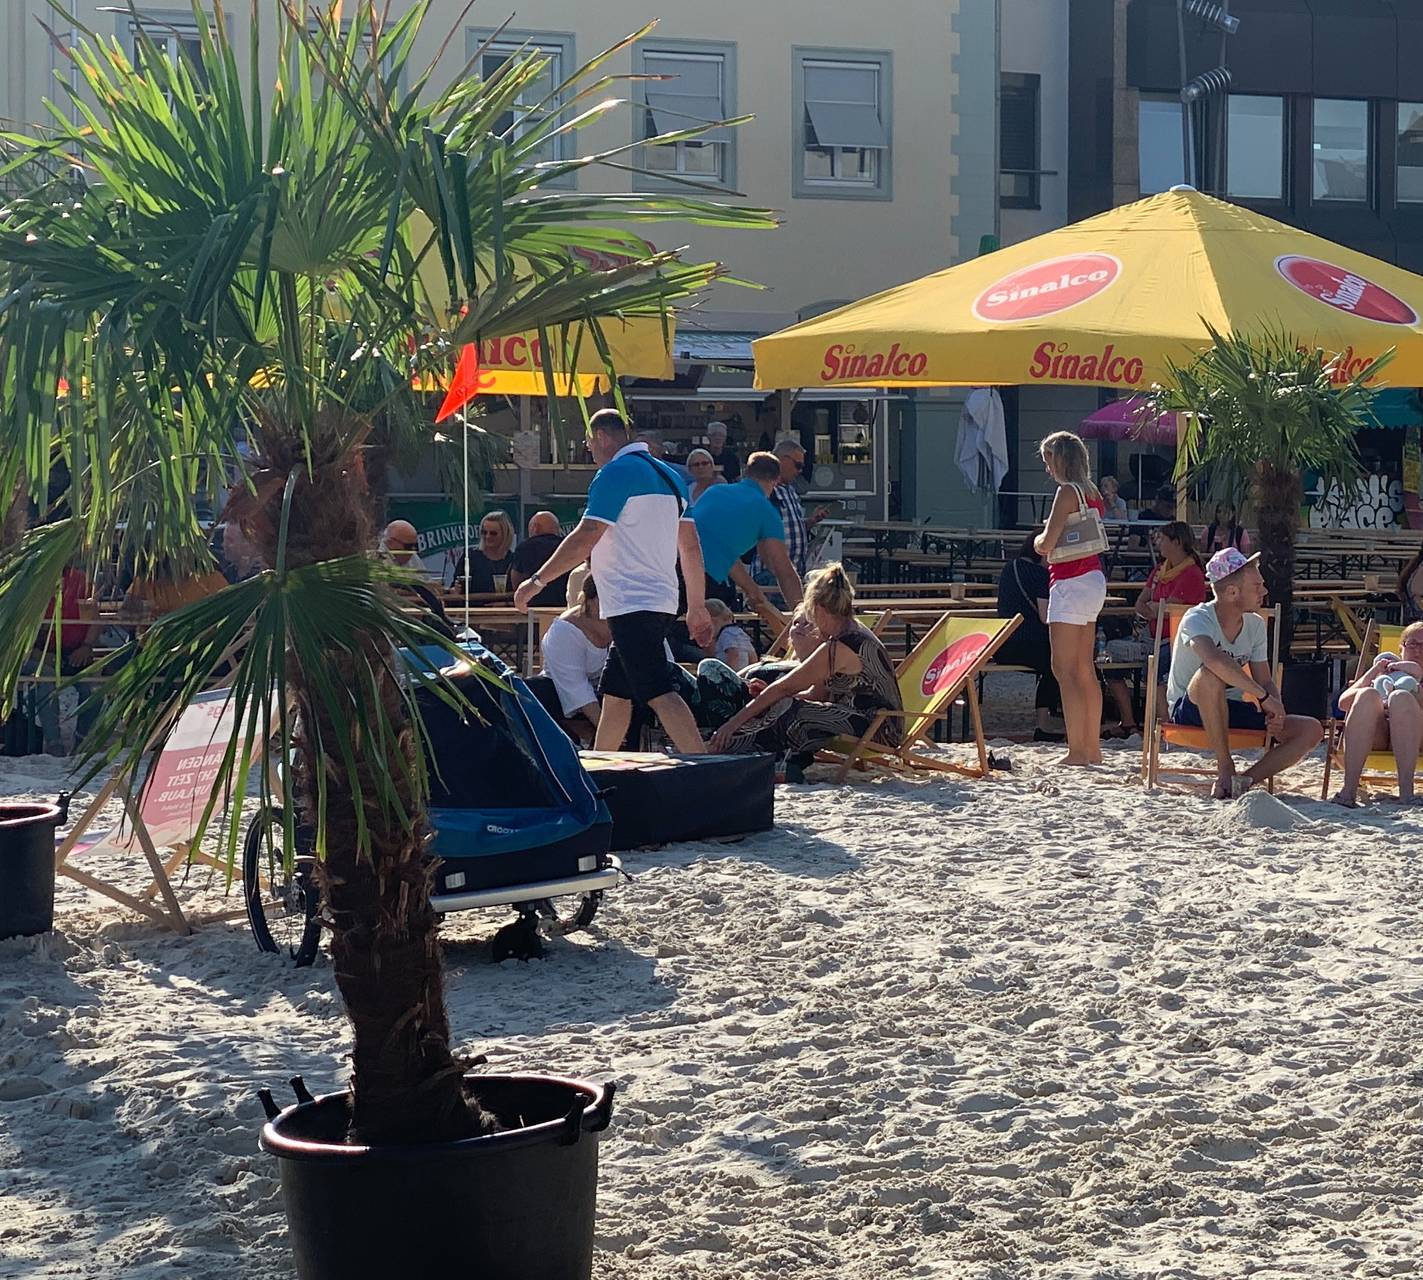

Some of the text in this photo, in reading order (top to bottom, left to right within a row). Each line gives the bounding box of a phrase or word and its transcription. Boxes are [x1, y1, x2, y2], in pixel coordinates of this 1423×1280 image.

[985, 267, 1109, 307] Sinalco
[1319, 273, 1367, 310] Sinalco
[821, 343, 928, 381] Sinalco
[1029, 341, 1144, 384] Sinalco
[417, 523, 480, 551] BRINKHOF
